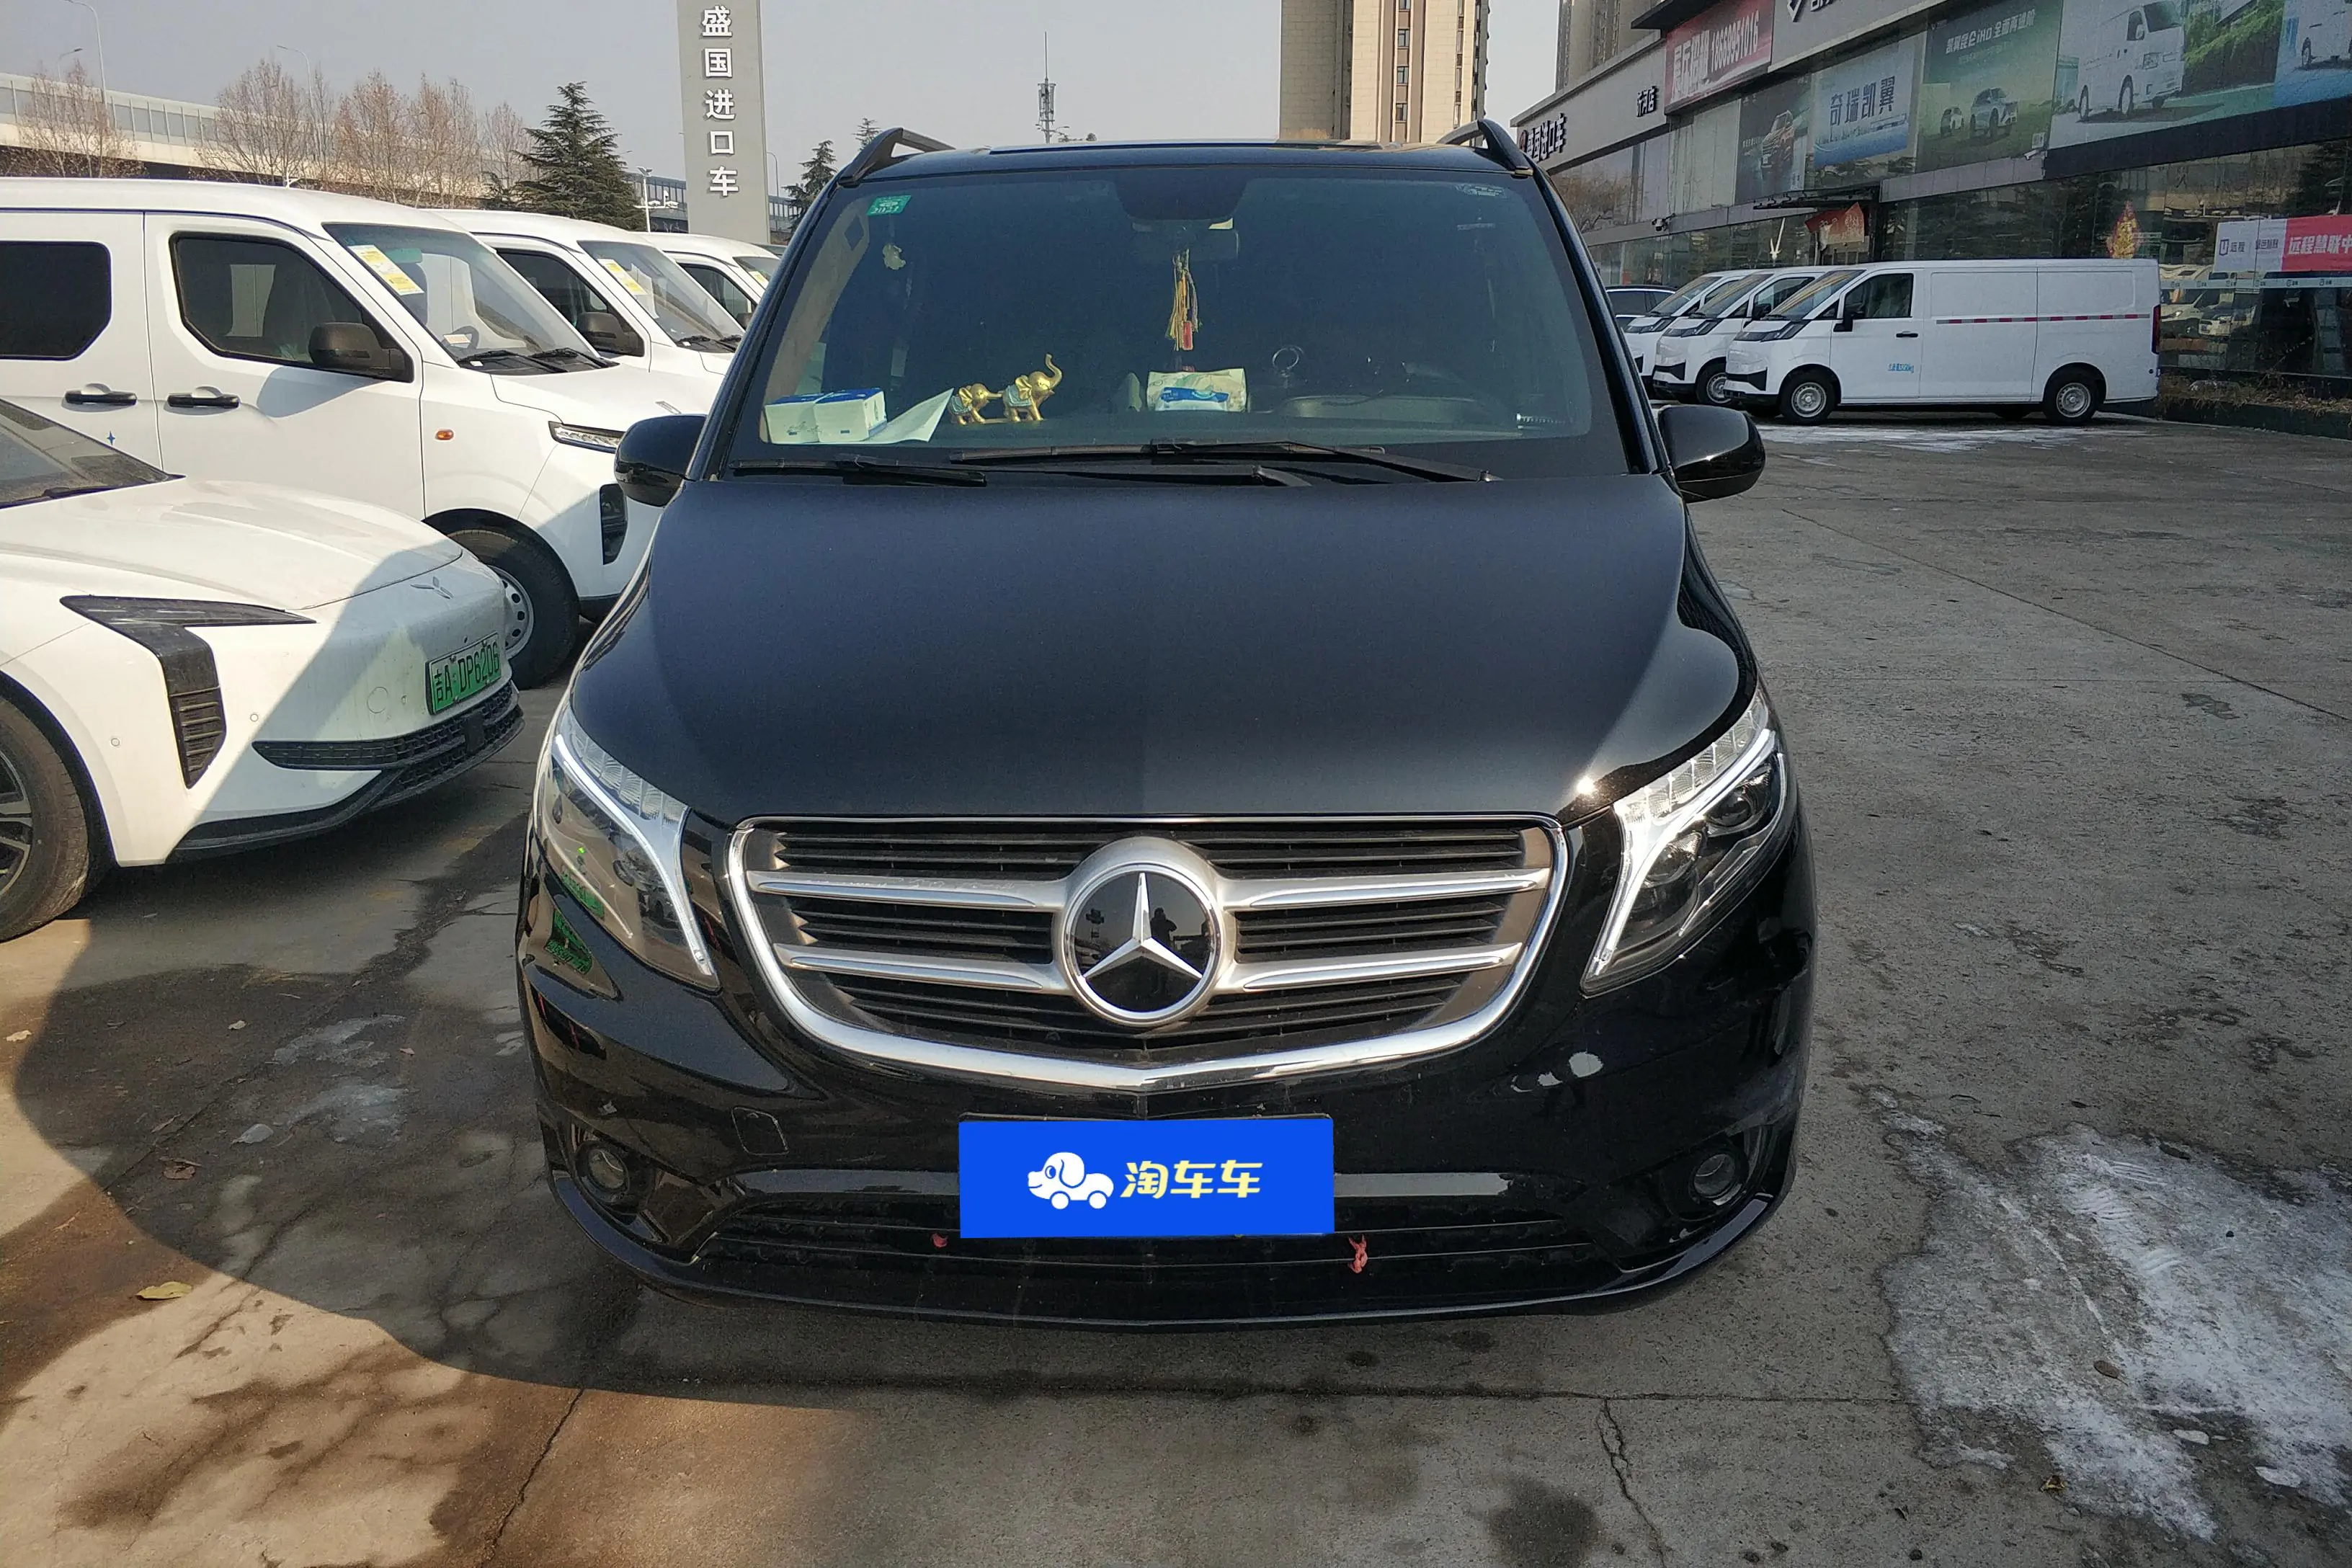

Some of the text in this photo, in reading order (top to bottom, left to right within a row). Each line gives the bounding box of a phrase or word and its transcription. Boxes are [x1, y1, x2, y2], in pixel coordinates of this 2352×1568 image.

[1711, 10, 1759, 72] 18669951016
[701, 5, 739, 197] 盛国进口车
[1830, 76, 1895, 126] 奇瑞凯翼
